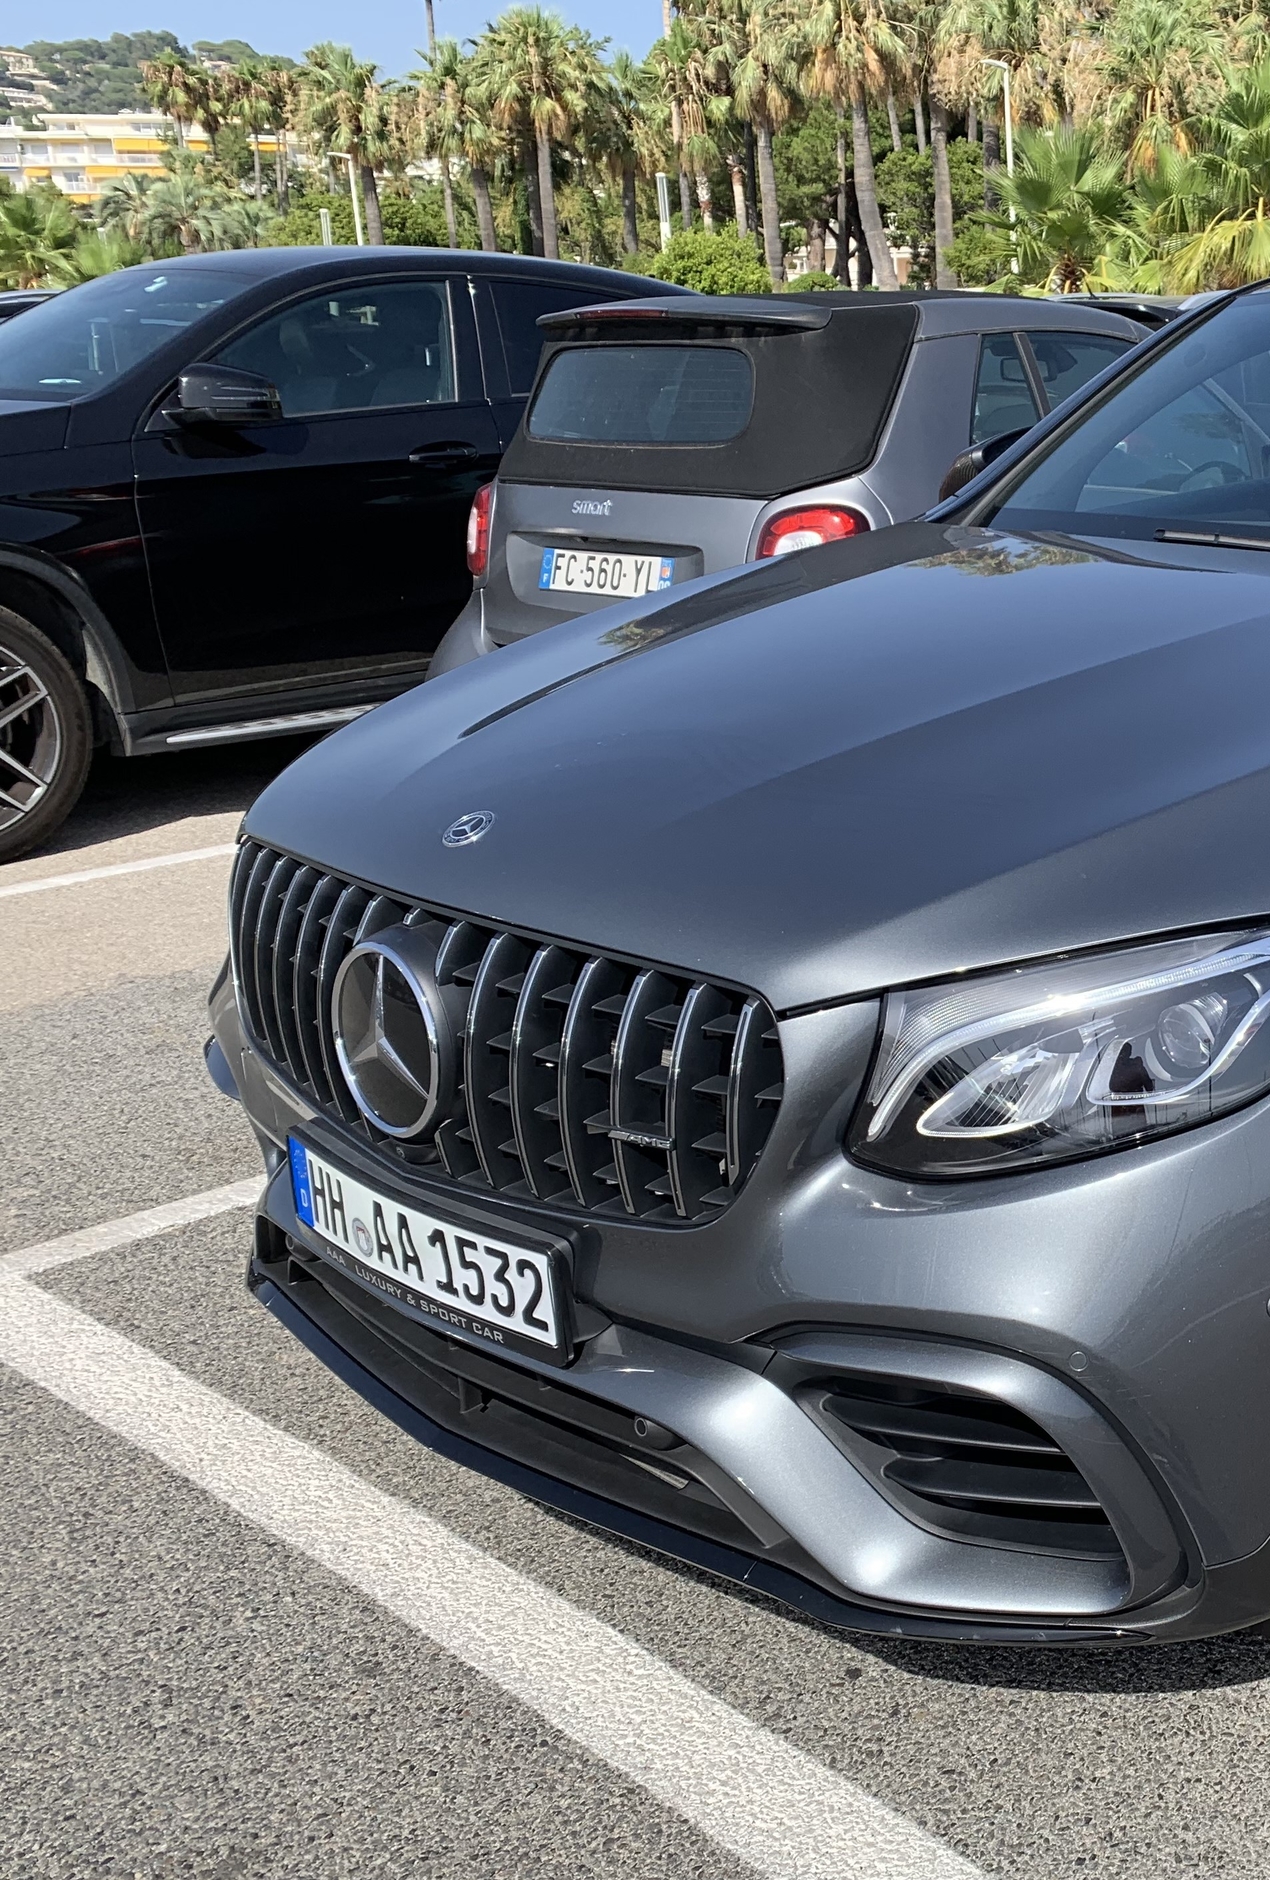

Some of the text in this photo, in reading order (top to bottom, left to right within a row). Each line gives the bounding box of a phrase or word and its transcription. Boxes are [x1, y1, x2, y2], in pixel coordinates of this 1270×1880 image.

[571, 499, 612, 516] smart
[542, 573, 549, 583] F
[628, 1133, 671, 1150] AMG
[300, 1187, 308, 1208] D
[308, 1158, 549, 1333] HH AA 1532
[326, 1246, 505, 1344] AAA LUXURY & SPORT CAR
